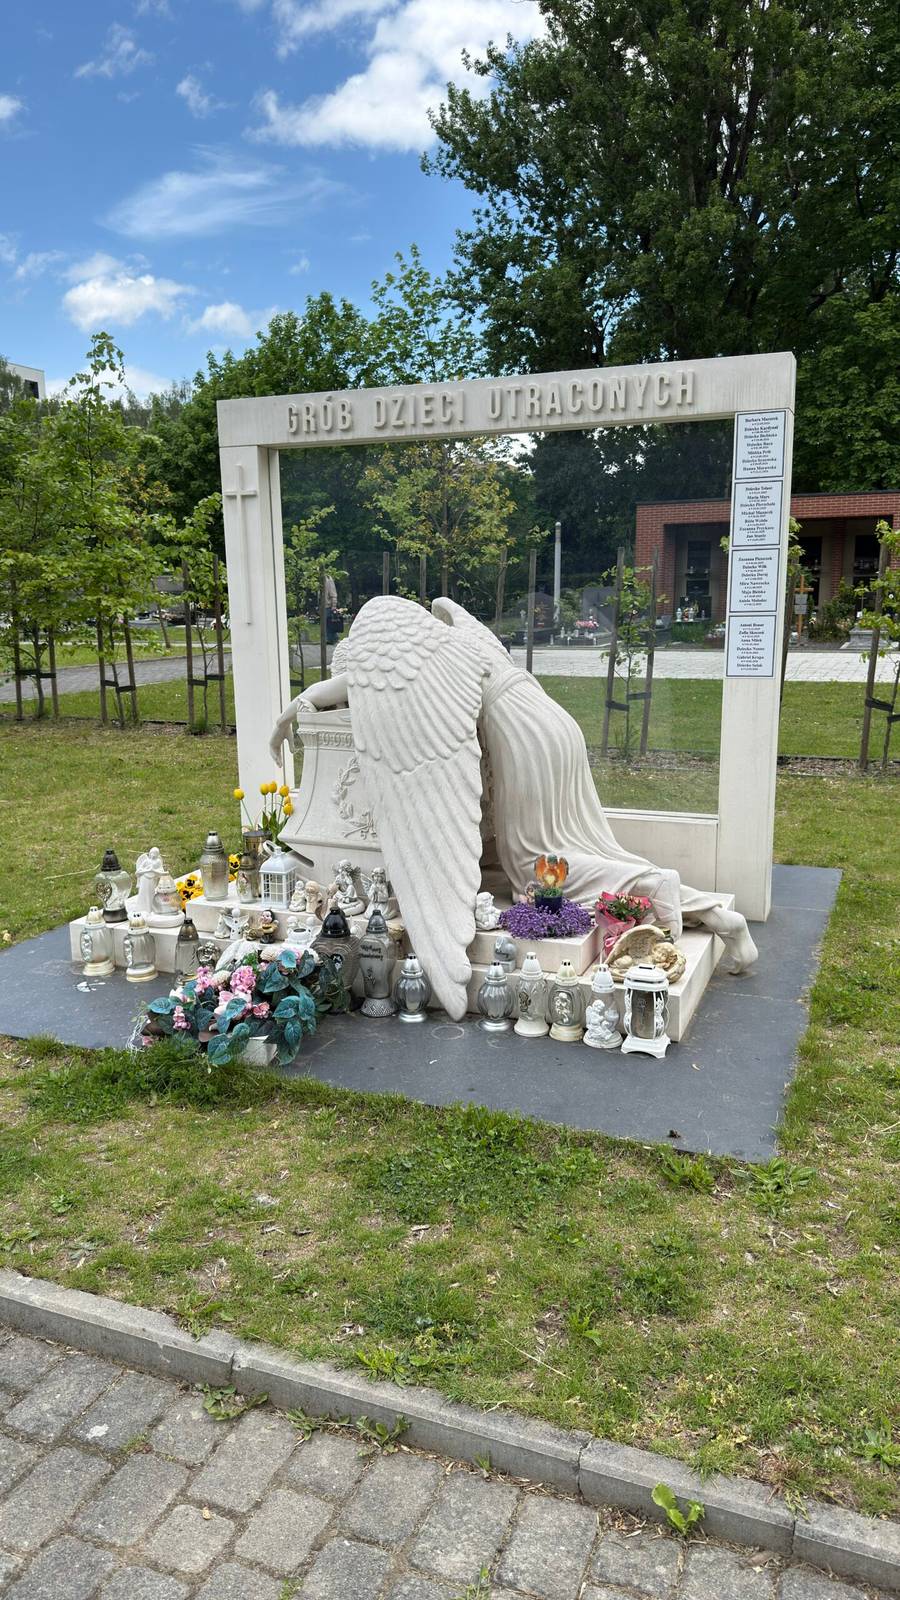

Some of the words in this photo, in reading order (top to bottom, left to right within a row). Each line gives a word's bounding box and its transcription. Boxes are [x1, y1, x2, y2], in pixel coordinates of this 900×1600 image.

[287, 396, 353, 435] GRÓB
[373, 390, 465, 430] DZIECI
[487, 371, 695, 420] UTRACONYCH
